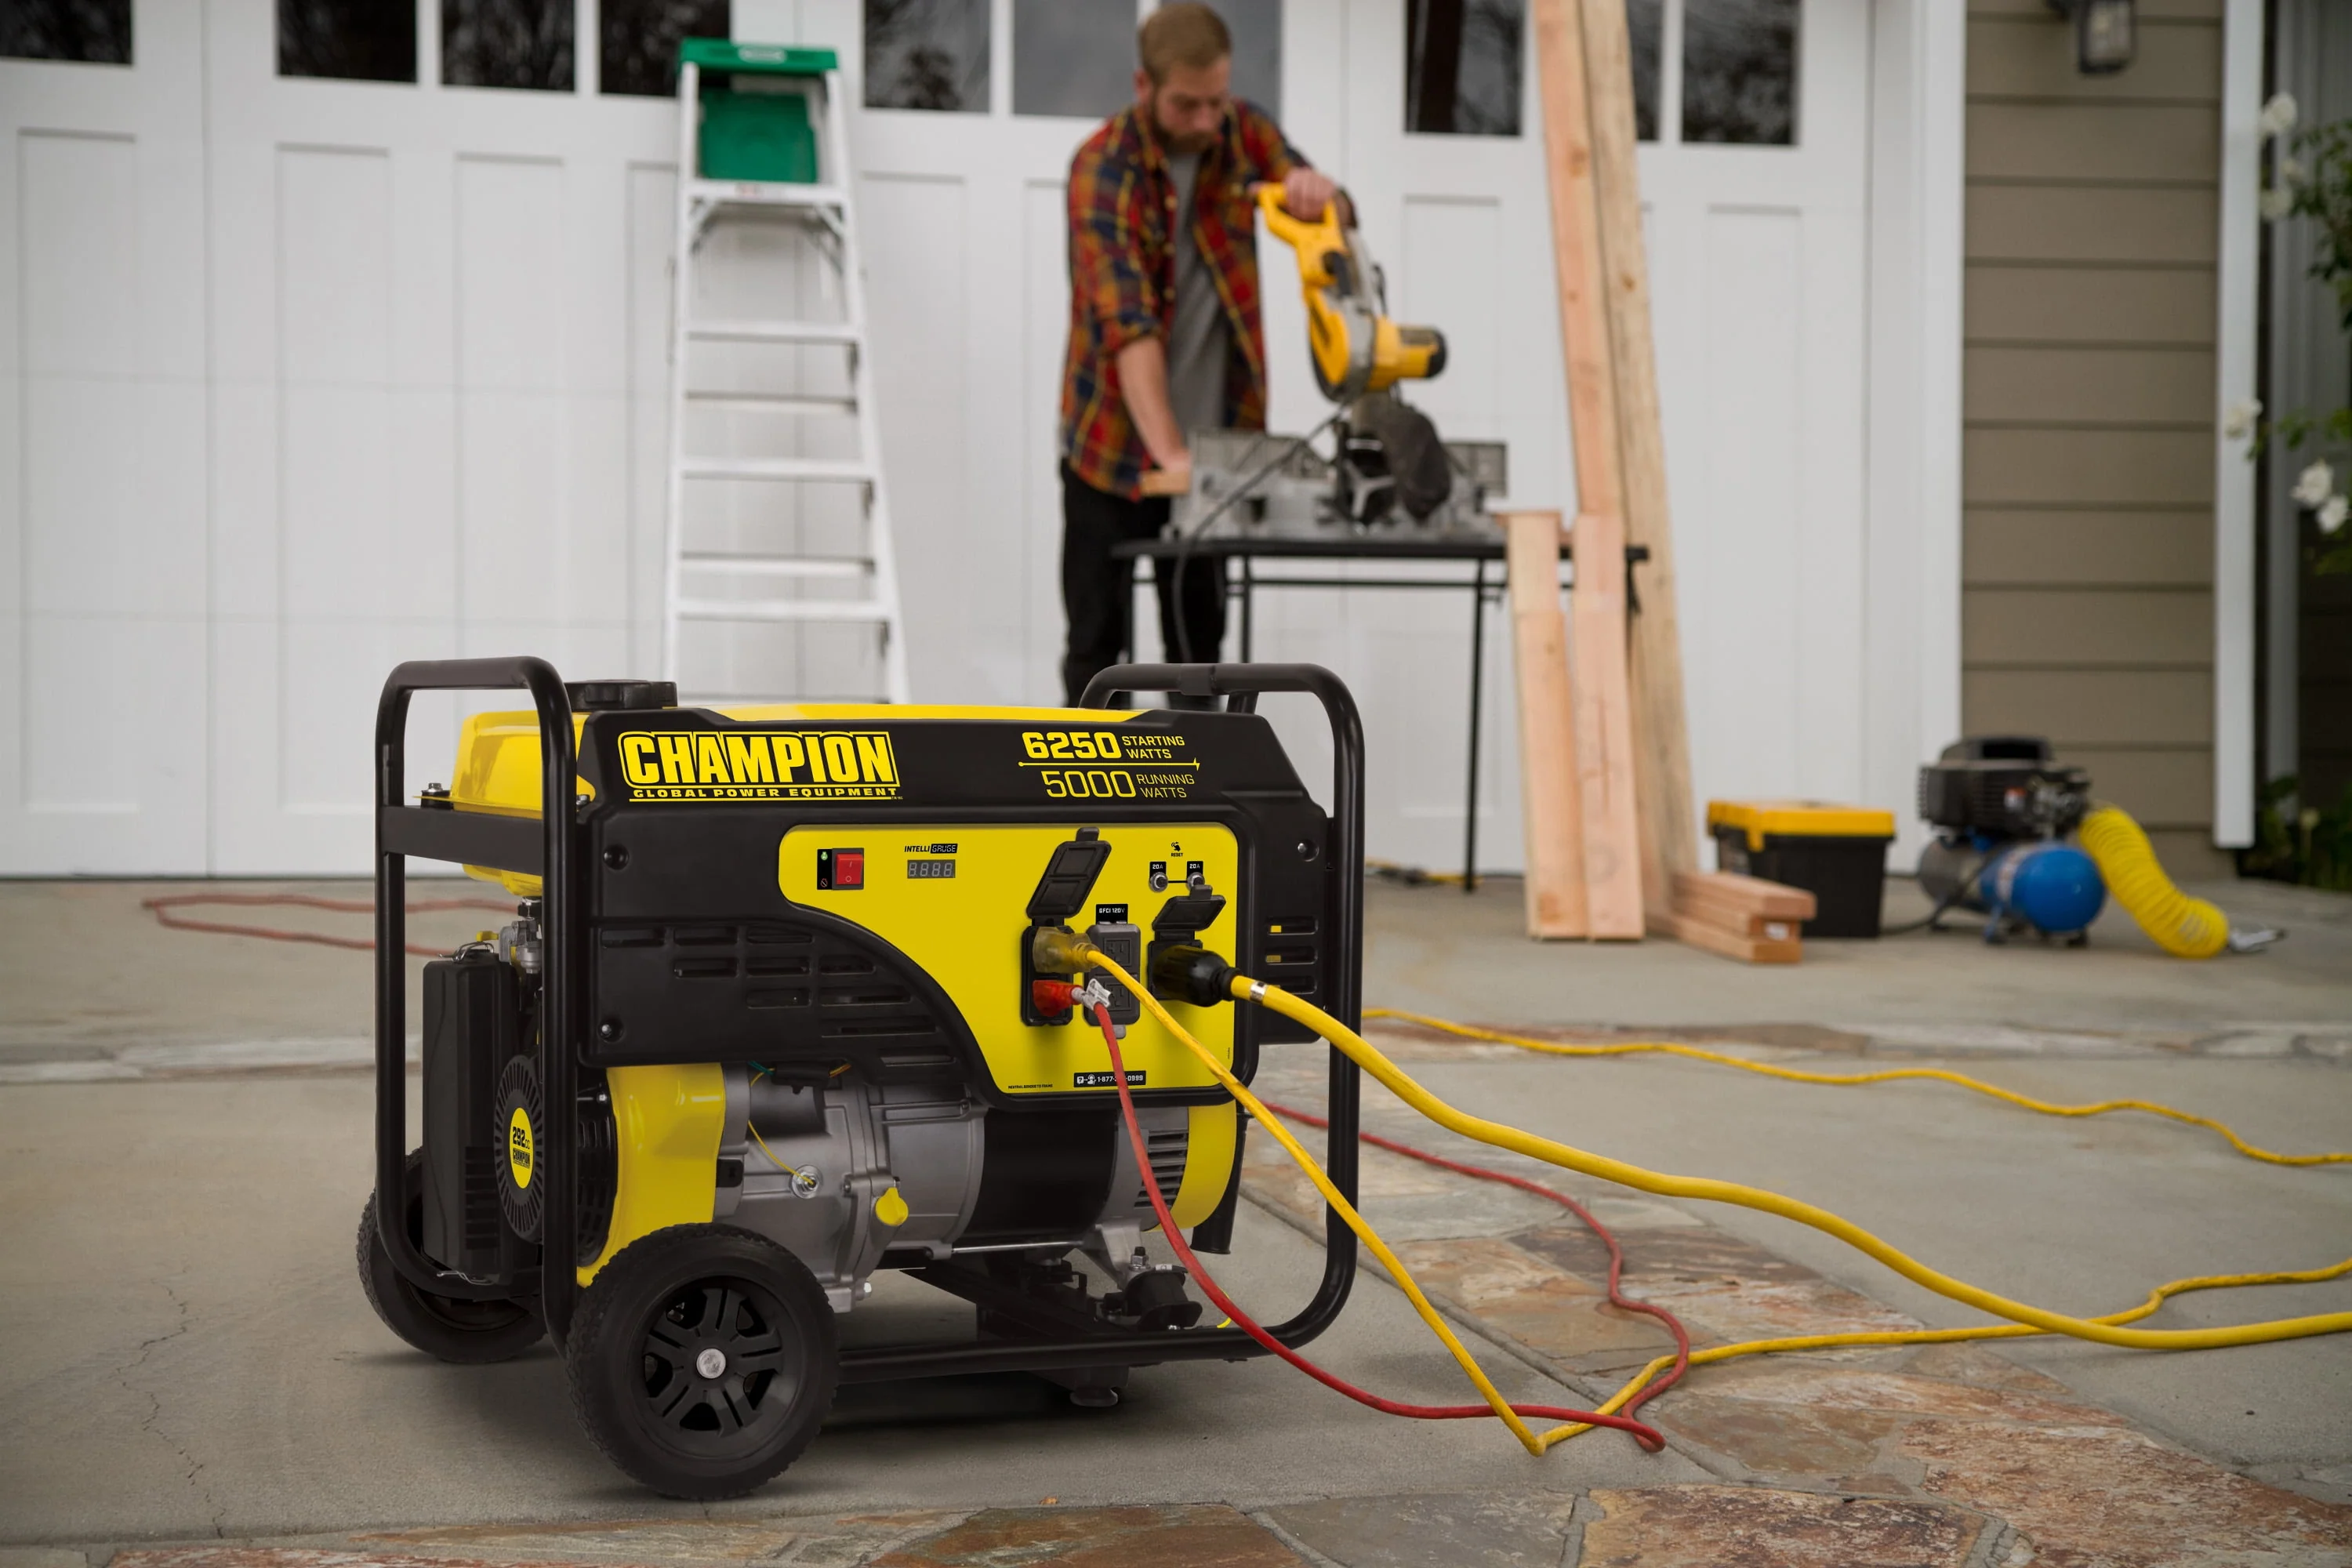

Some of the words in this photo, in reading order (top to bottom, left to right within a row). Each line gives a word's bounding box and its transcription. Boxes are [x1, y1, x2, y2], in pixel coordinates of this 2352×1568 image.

[1022, 731, 1122, 759] 6250
[1122, 736, 1185, 746] STARTING
[1126, 748, 1172, 759] WATTS
[622, 735, 895, 784] CHAMPION
[1040, 771, 1137, 797] 5000
[1136, 774, 1195, 785] RUNNING
[633, 789, 706, 798] GLOBAL
[713, 789, 780, 797] POWER
[789, 788, 896, 797] EQUIPMENT
[1140, 787, 1187, 798] WATTS
